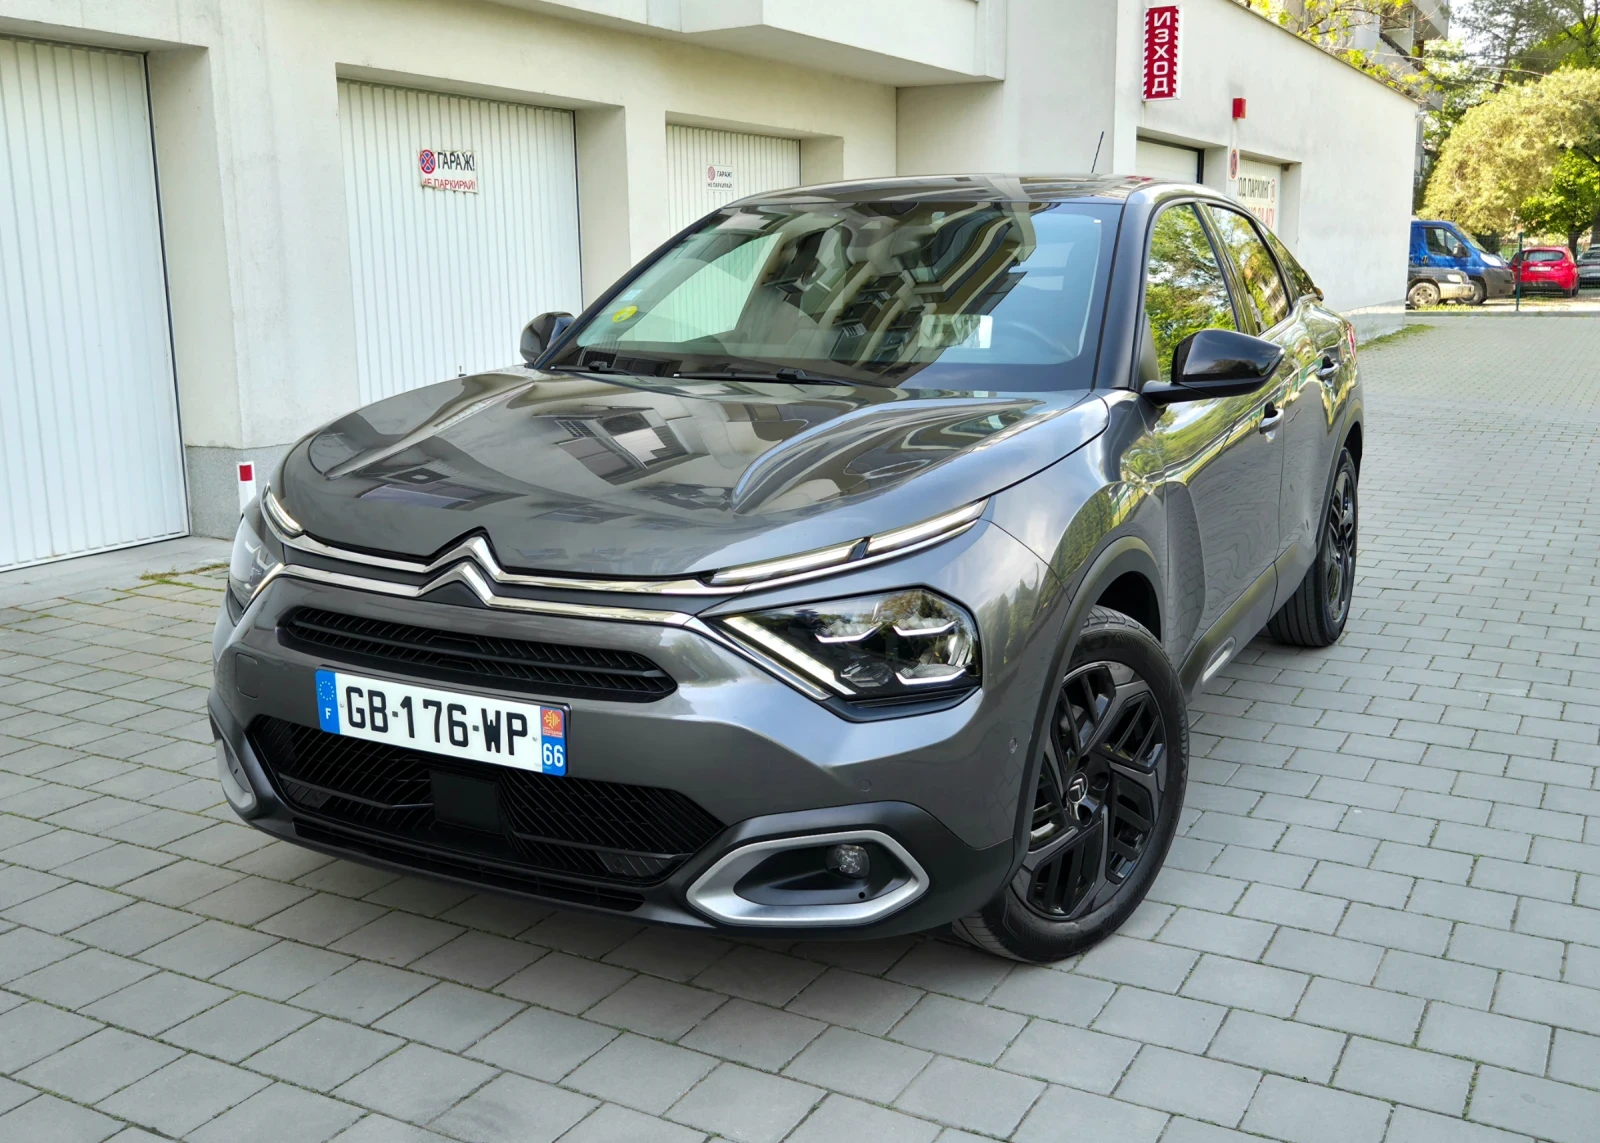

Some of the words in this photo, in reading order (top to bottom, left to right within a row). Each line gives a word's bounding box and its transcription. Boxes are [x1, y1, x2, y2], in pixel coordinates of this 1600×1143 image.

[1151, 11, 1171, 95] ИЗХОД
[437, 151, 475, 171] ГАРАЖ!
[1247, 178, 1270, 199] ПАРКИНГ
[325, 707, 332, 720] F
[345, 686, 528, 756] GB-176-WP
[542, 742, 564, 768] 66
